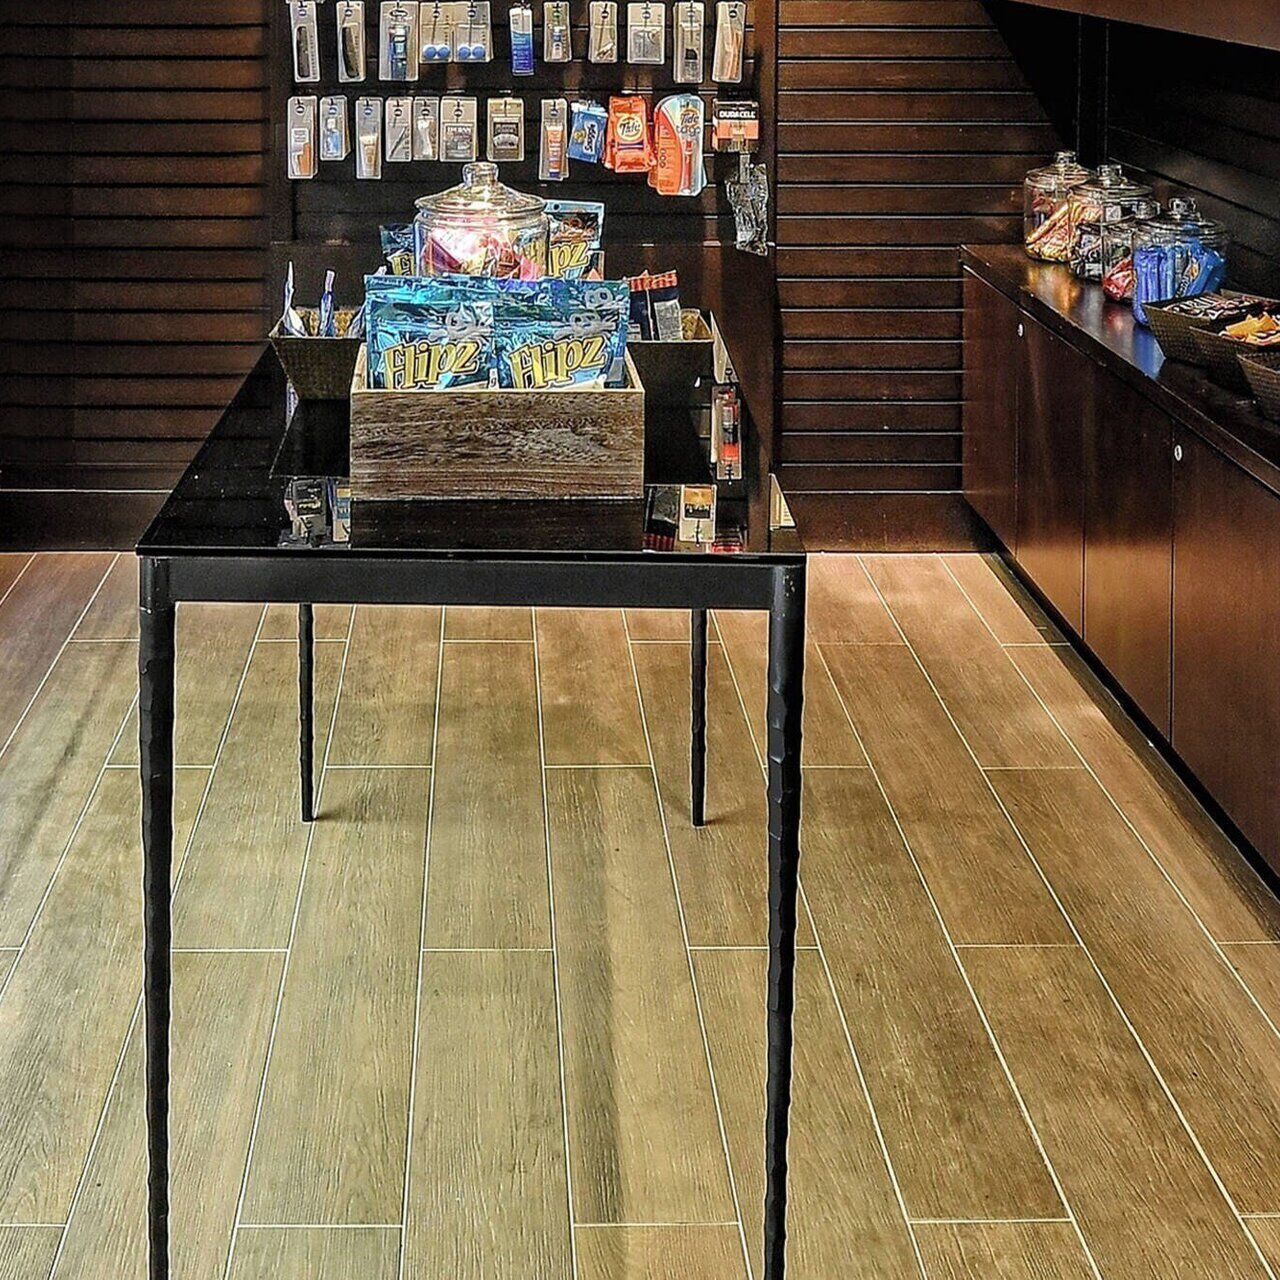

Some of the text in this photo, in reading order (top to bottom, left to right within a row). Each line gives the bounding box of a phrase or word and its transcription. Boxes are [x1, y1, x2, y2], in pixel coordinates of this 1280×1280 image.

[718, 109, 756, 119] DURACELL
[382, 338, 480, 389] Flipz
[510, 335, 606, 389] Flipz
